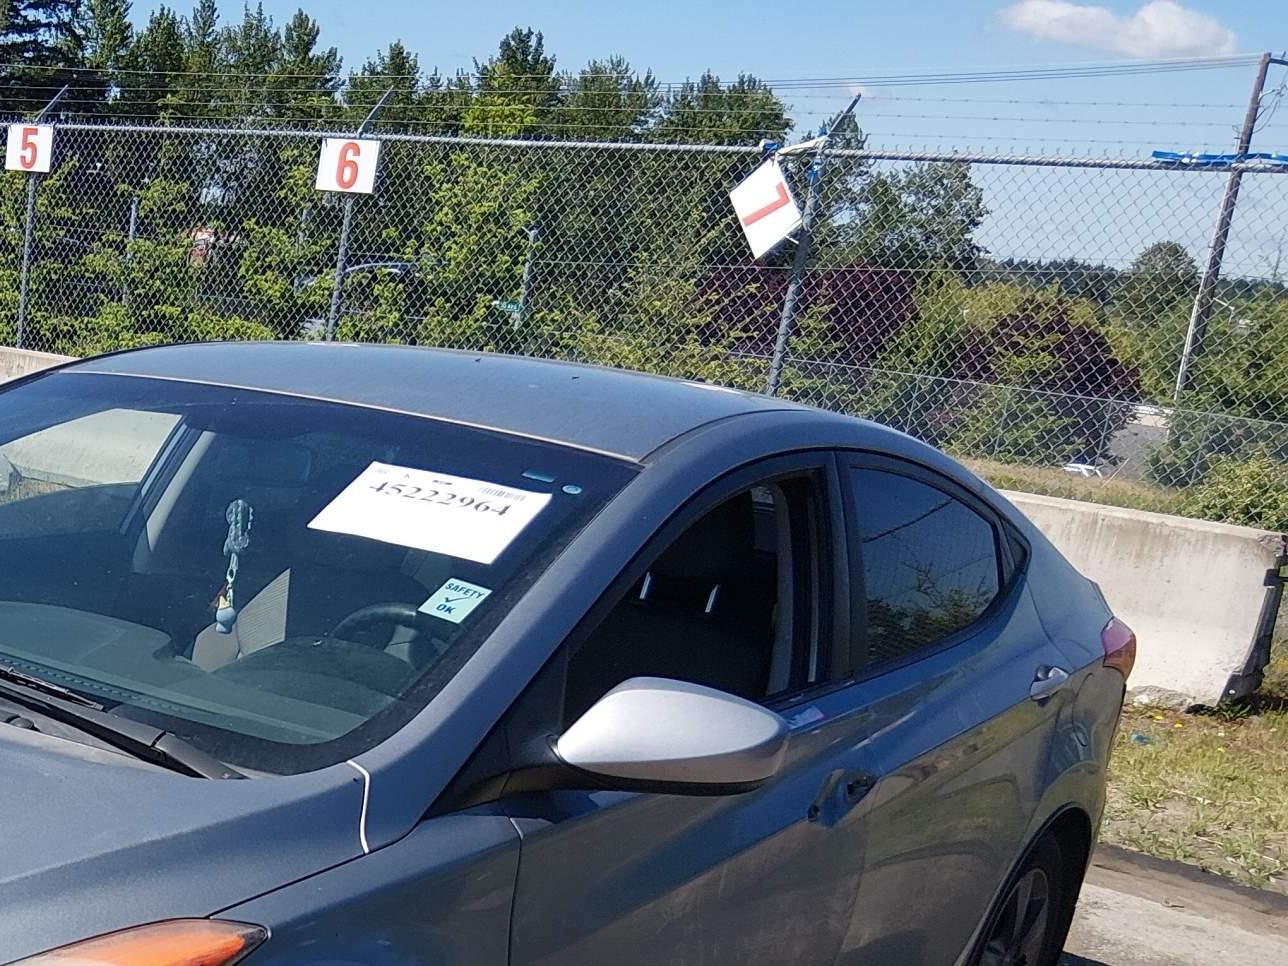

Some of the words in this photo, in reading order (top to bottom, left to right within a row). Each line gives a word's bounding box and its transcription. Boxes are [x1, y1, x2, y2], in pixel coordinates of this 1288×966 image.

[20, 127, 38, 169] 5
[336, 142, 360, 189] 6
[742, 181, 790, 227] 7
[369, 481, 512, 516] 45222964
[436, 603, 456, 615] OK
[445, 583, 485, 599] SAFETY
